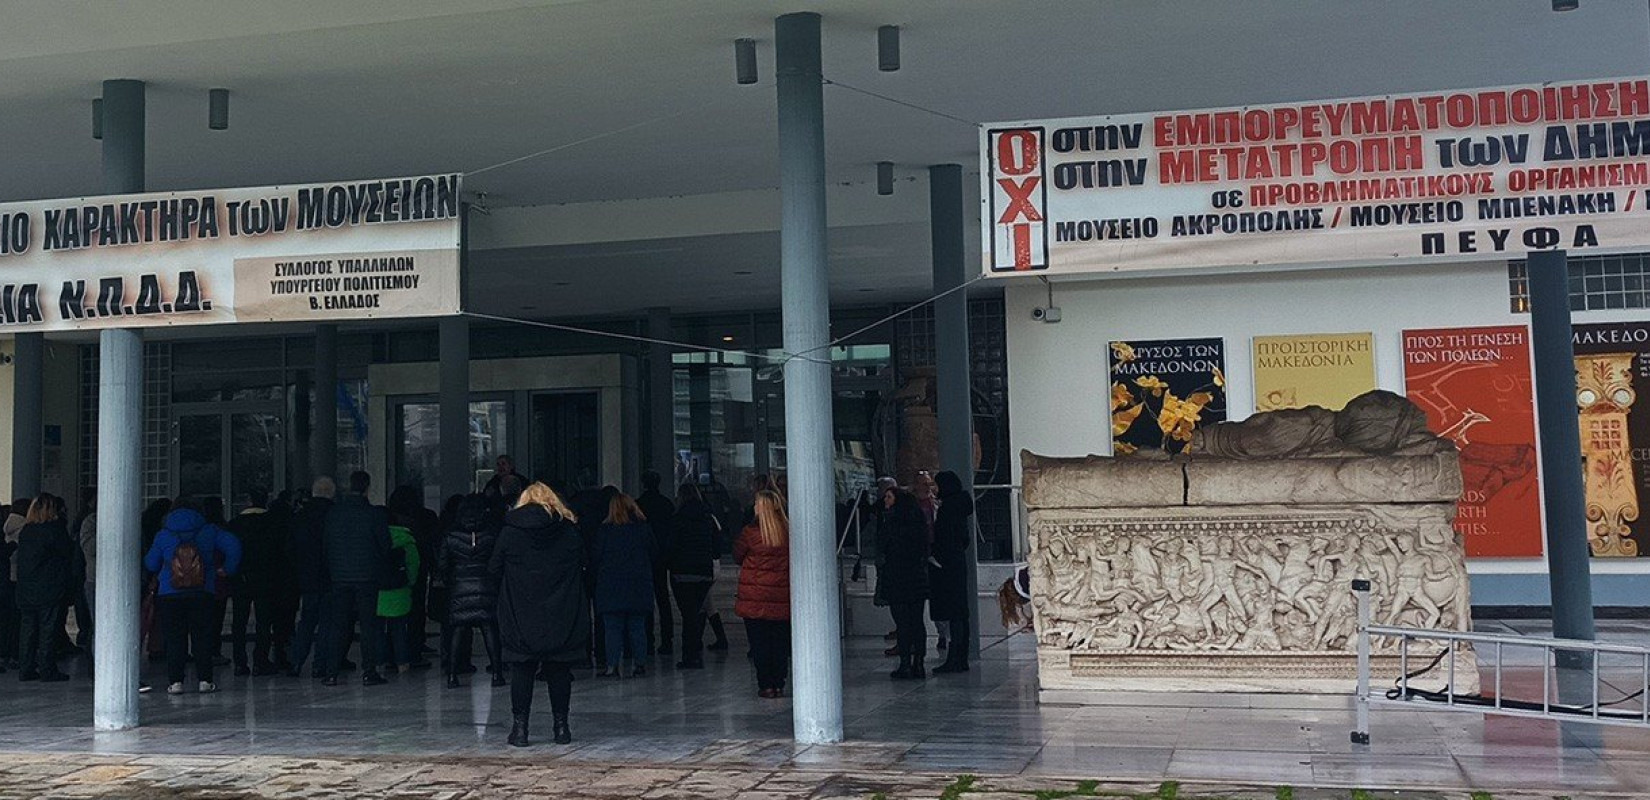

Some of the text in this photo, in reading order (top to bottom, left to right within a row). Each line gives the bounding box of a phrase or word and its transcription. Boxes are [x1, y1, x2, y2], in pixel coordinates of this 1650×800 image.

[1052, 81, 1649, 153] στην ΕΜΠΟΡΕΥΜΑΤΟΠΟΙΗΣΗ
[1053, 121, 1650, 190] στην ΜΕΤΑΤΡΟΠΗ των ΔΗΜ
[1211, 163, 1648, 209] σε ΠΡΟΒΛΗΜΑΤΙΚΟΥΣ ΟΡΓΑΝΙΣΜ
[997, 129, 1043, 271] ΟΧΙ
[43, 197, 218, 250] ΧΑΡΑΚΤΗΡΑ
[227, 197, 289, 236] των
[297, 174, 458, 231] ΜΟΥΣΕΙΩΝ
[1056, 217, 1159, 242] ΜΟΥΣΕΙΟ
[1171, 208, 1325, 237] ΑΚΡΟΠΟΛΗΣ
[1351, 200, 1464, 227] ΜΟΥΣΕΙΟ
[1478, 192, 1616, 220] ΜΠΕΝΑΚΗ
[275, 257, 414, 276] ΣΥΛΛΟΓΟΣ ΥΠΑΛΛΗΛΩΝ
[271, 274, 420, 294] ΥΠΟΥΡΓΕΙΟΥ ΠΟΛΙΤΙΣΜΟΥ
[0, 271, 212, 323] ΙΑ Ν.Π.Δ.Δ.
[310, 294, 380, 310] Β. ΕΛΛΑΔΟΣ
[1258, 340, 1369, 354] ΠΡΟΙΣΤΟΡΙΚΗ
[1407, 333, 1522, 348] ΠΡΟΣ ΤΗ ΓΕΝΕΣΗ
[1187, 345, 1219, 357] ΤΩΝ
[1406, 351, 1438, 363] ΤΩΝ
[1115, 360, 1219, 374] ΜΑΚΕΔΟΝΩΝ
[1258, 354, 1354, 368] ΜΑΚΕΔΟΝΙΑ
[1610, 448, 1650, 461] MACE
